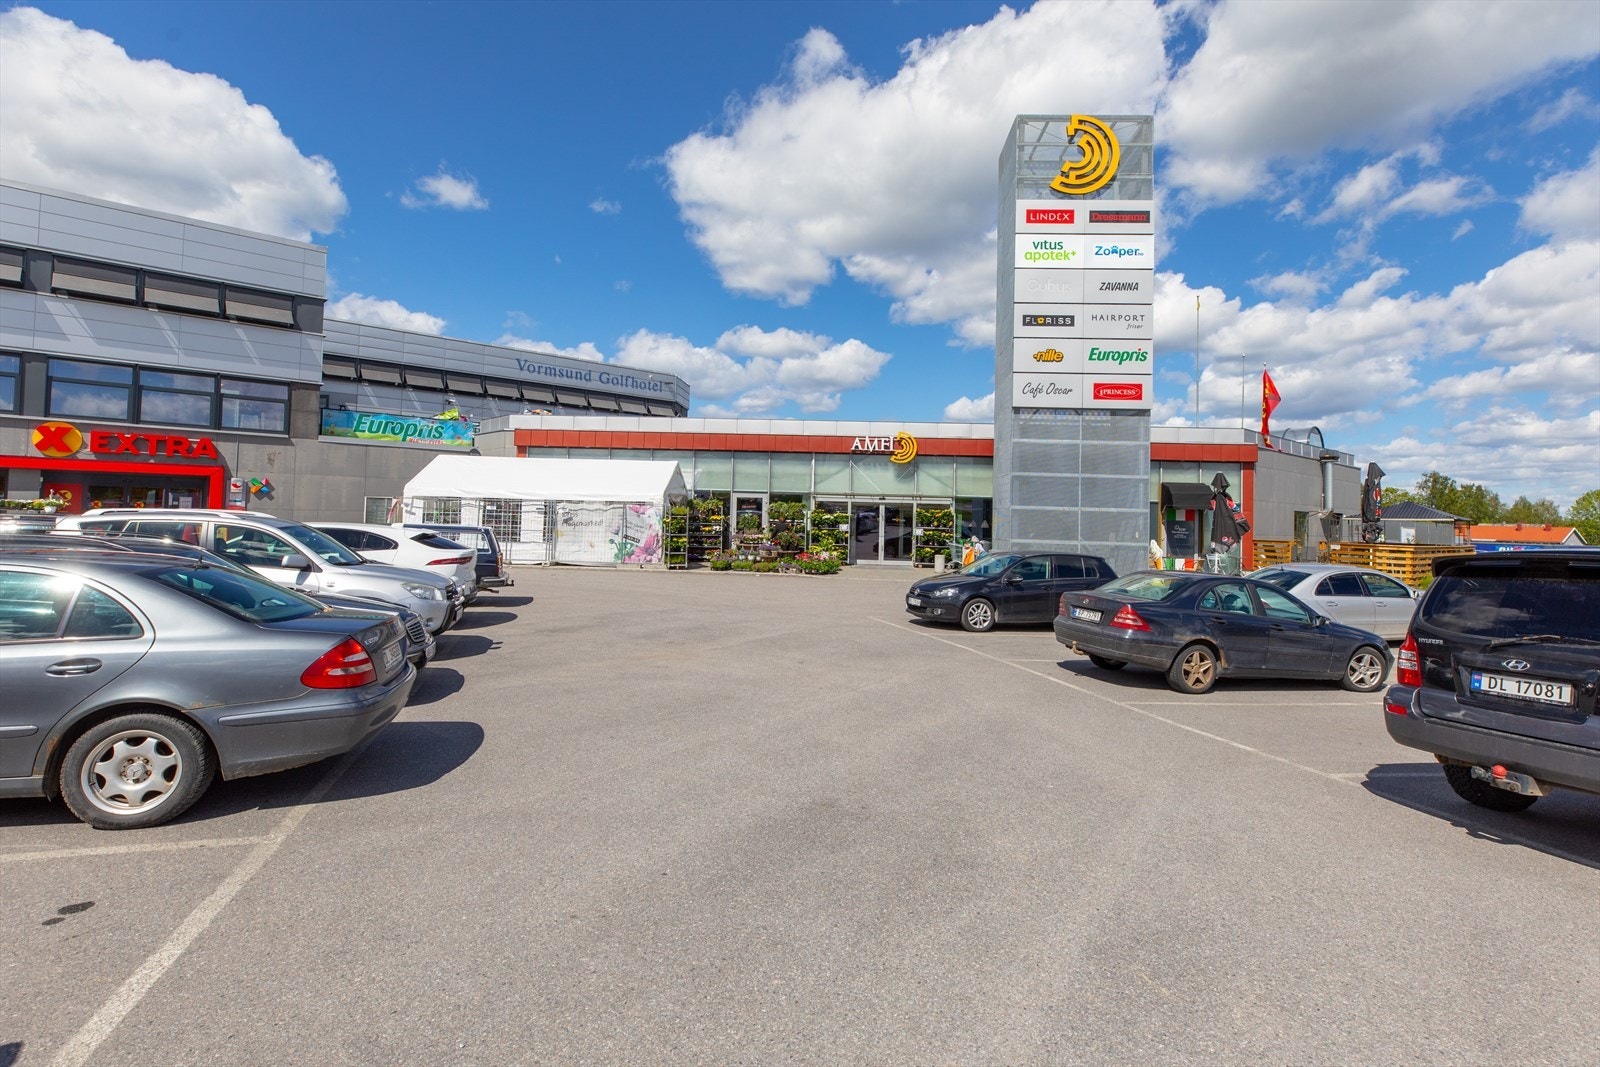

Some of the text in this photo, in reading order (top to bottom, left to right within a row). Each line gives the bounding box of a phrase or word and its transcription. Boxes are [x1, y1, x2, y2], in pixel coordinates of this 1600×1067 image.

[1030, 212, 1070, 221] LINDEX
[1091, 212, 1147, 221] Dressmann
[1032, 240, 1064, 250] vitus
[1027, 279, 1072, 292] Cubus
[1099, 282, 1139, 291] ZAVANNA
[1025, 316, 1072, 325] FLORISS
[1091, 314, 1146, 322] HAIRPORT
[1088, 347, 1148, 365] Europris
[516, 358, 664, 392] Vormsund Golfhotel
[1022, 382, 1073, 398] Café Oscar
[353, 413, 445, 442] Europris
[90, 430, 218, 459] EXTRA
[850, 436, 895, 452] AMFI
[1488, 677, 1506, 691] DL
[1515, 681, 1563, 700] 17081
